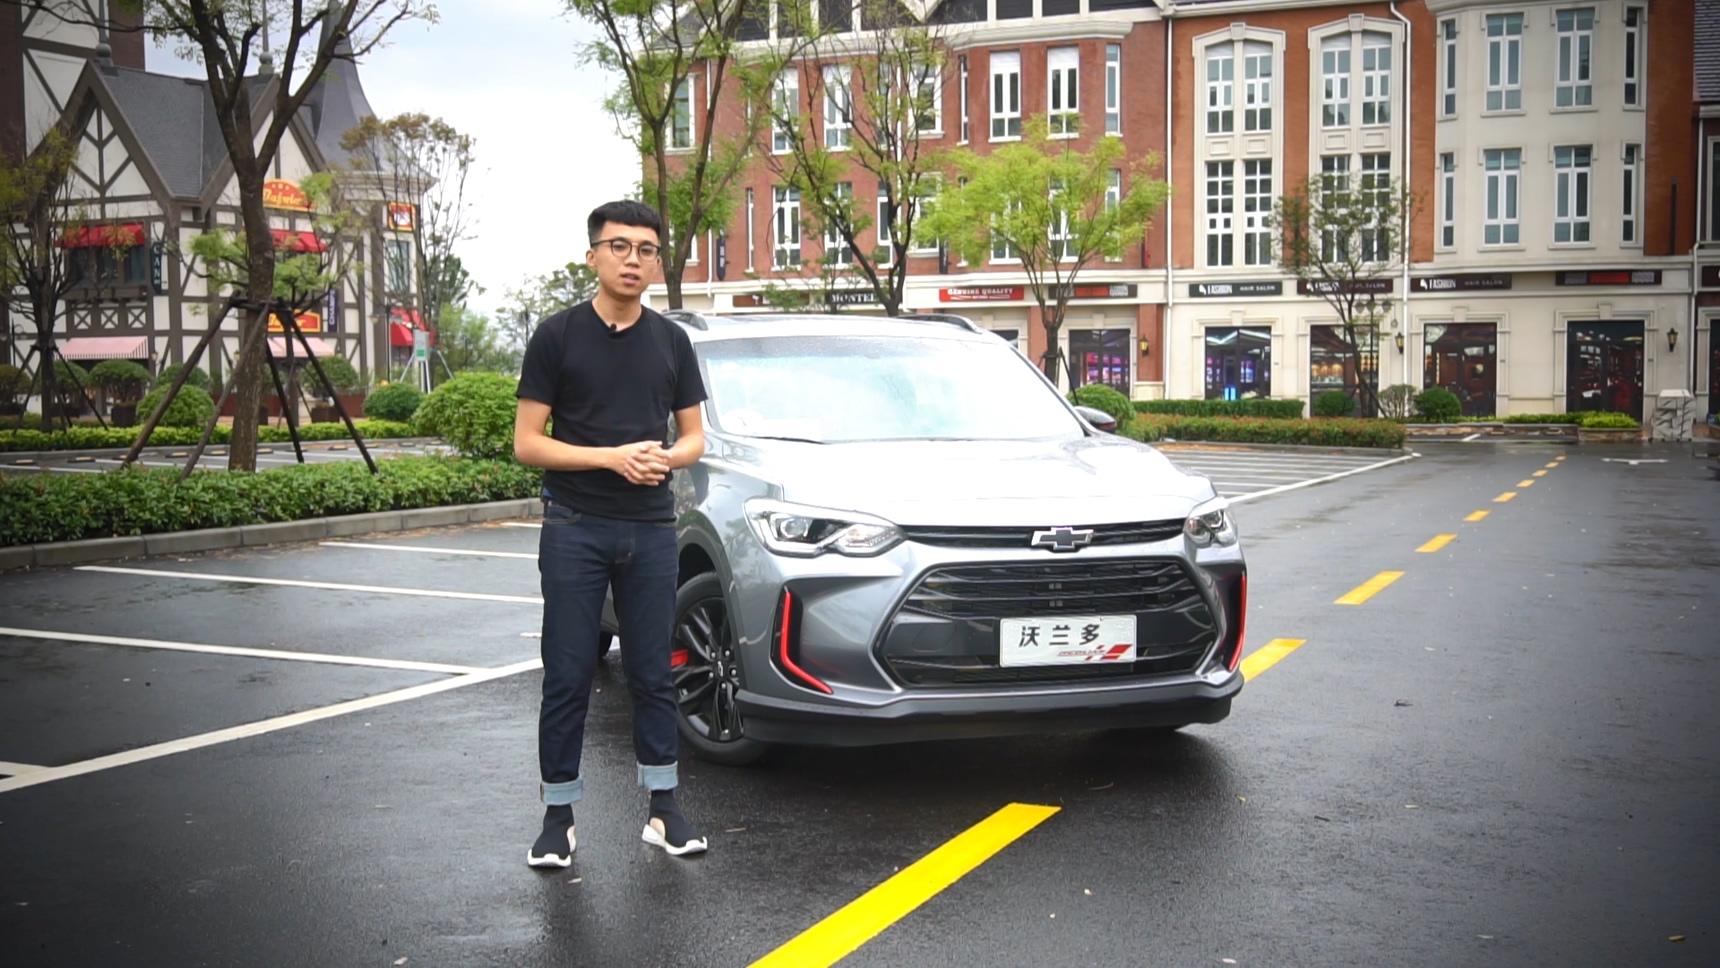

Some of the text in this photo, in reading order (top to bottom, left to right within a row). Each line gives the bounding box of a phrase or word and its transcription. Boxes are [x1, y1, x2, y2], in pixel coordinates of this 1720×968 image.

[981, 287, 1013, 295] QUALITY
[1018, 623, 1101, 648] 沃兰多
